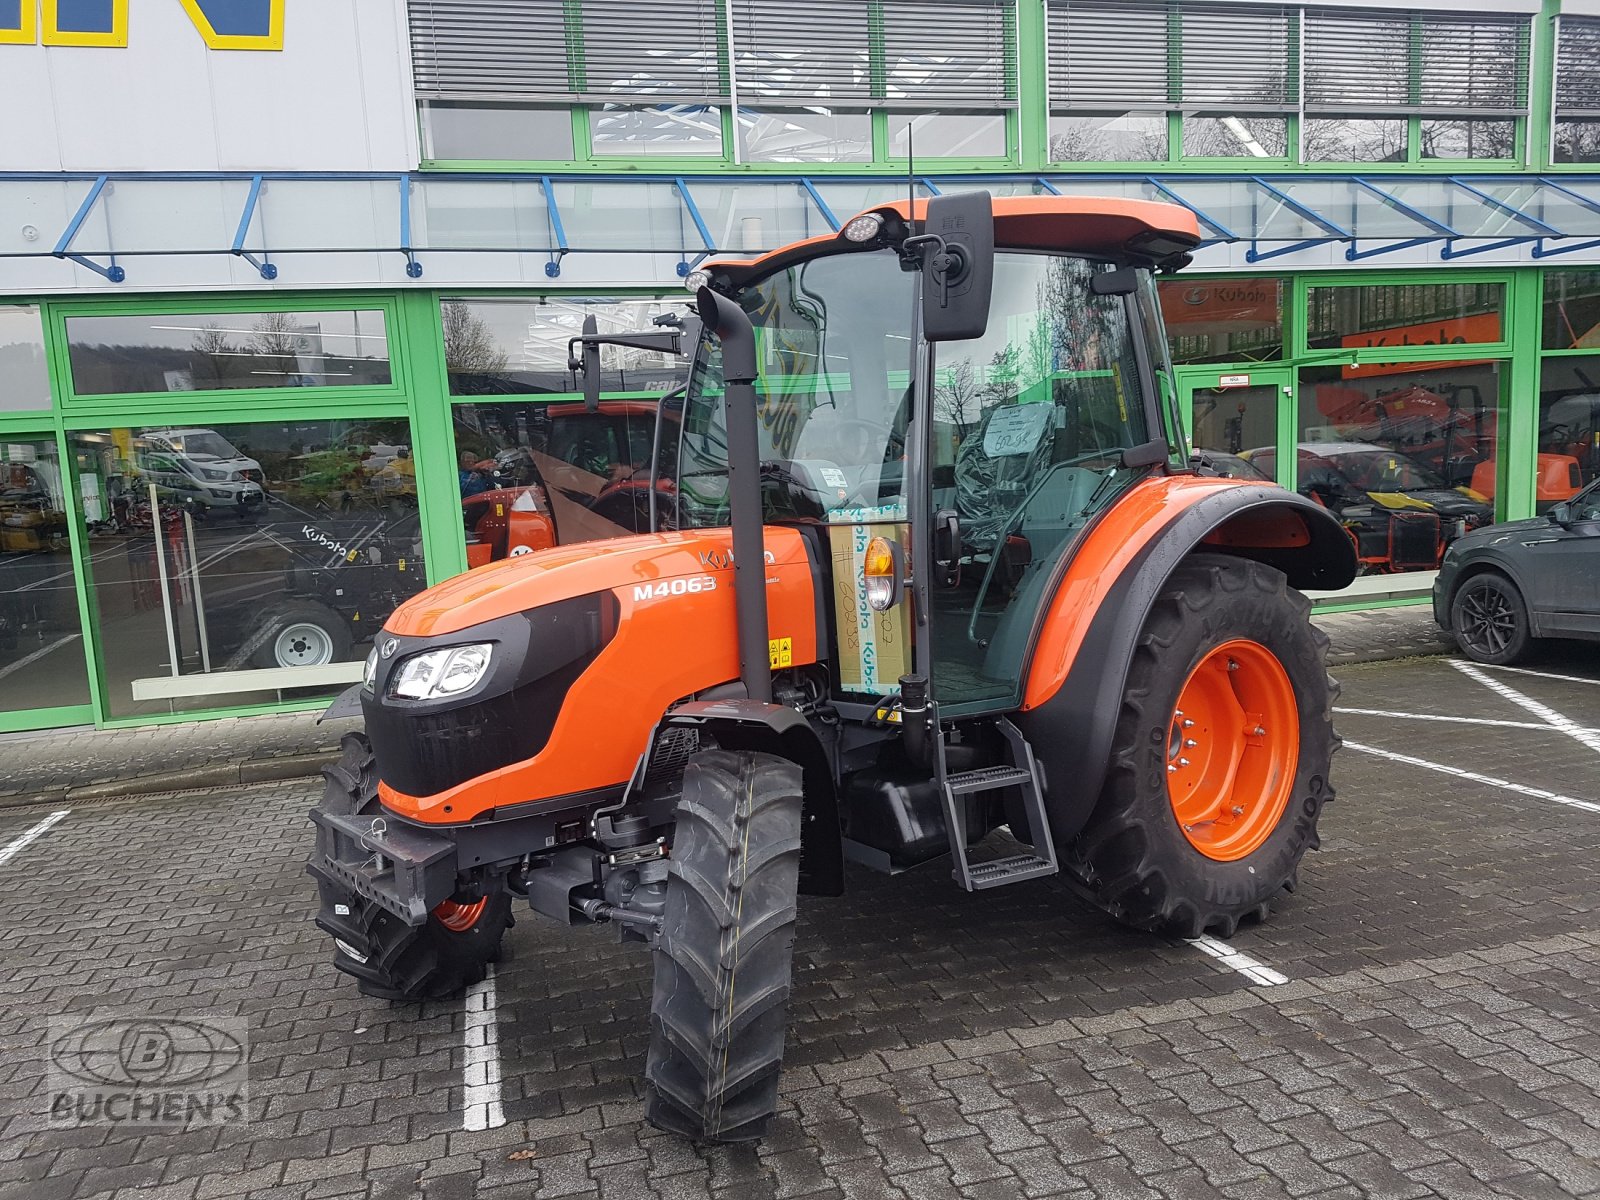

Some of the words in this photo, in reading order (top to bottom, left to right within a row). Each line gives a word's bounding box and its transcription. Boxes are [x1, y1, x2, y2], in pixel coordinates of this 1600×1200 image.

[1214, 287, 1266, 302] Kubota
[302, 525, 347, 557] Kubota
[699, 548, 776, 569] Kua
[633, 576, 717, 602] M4063
[1203, 773, 1324, 906] CONTINTAL
